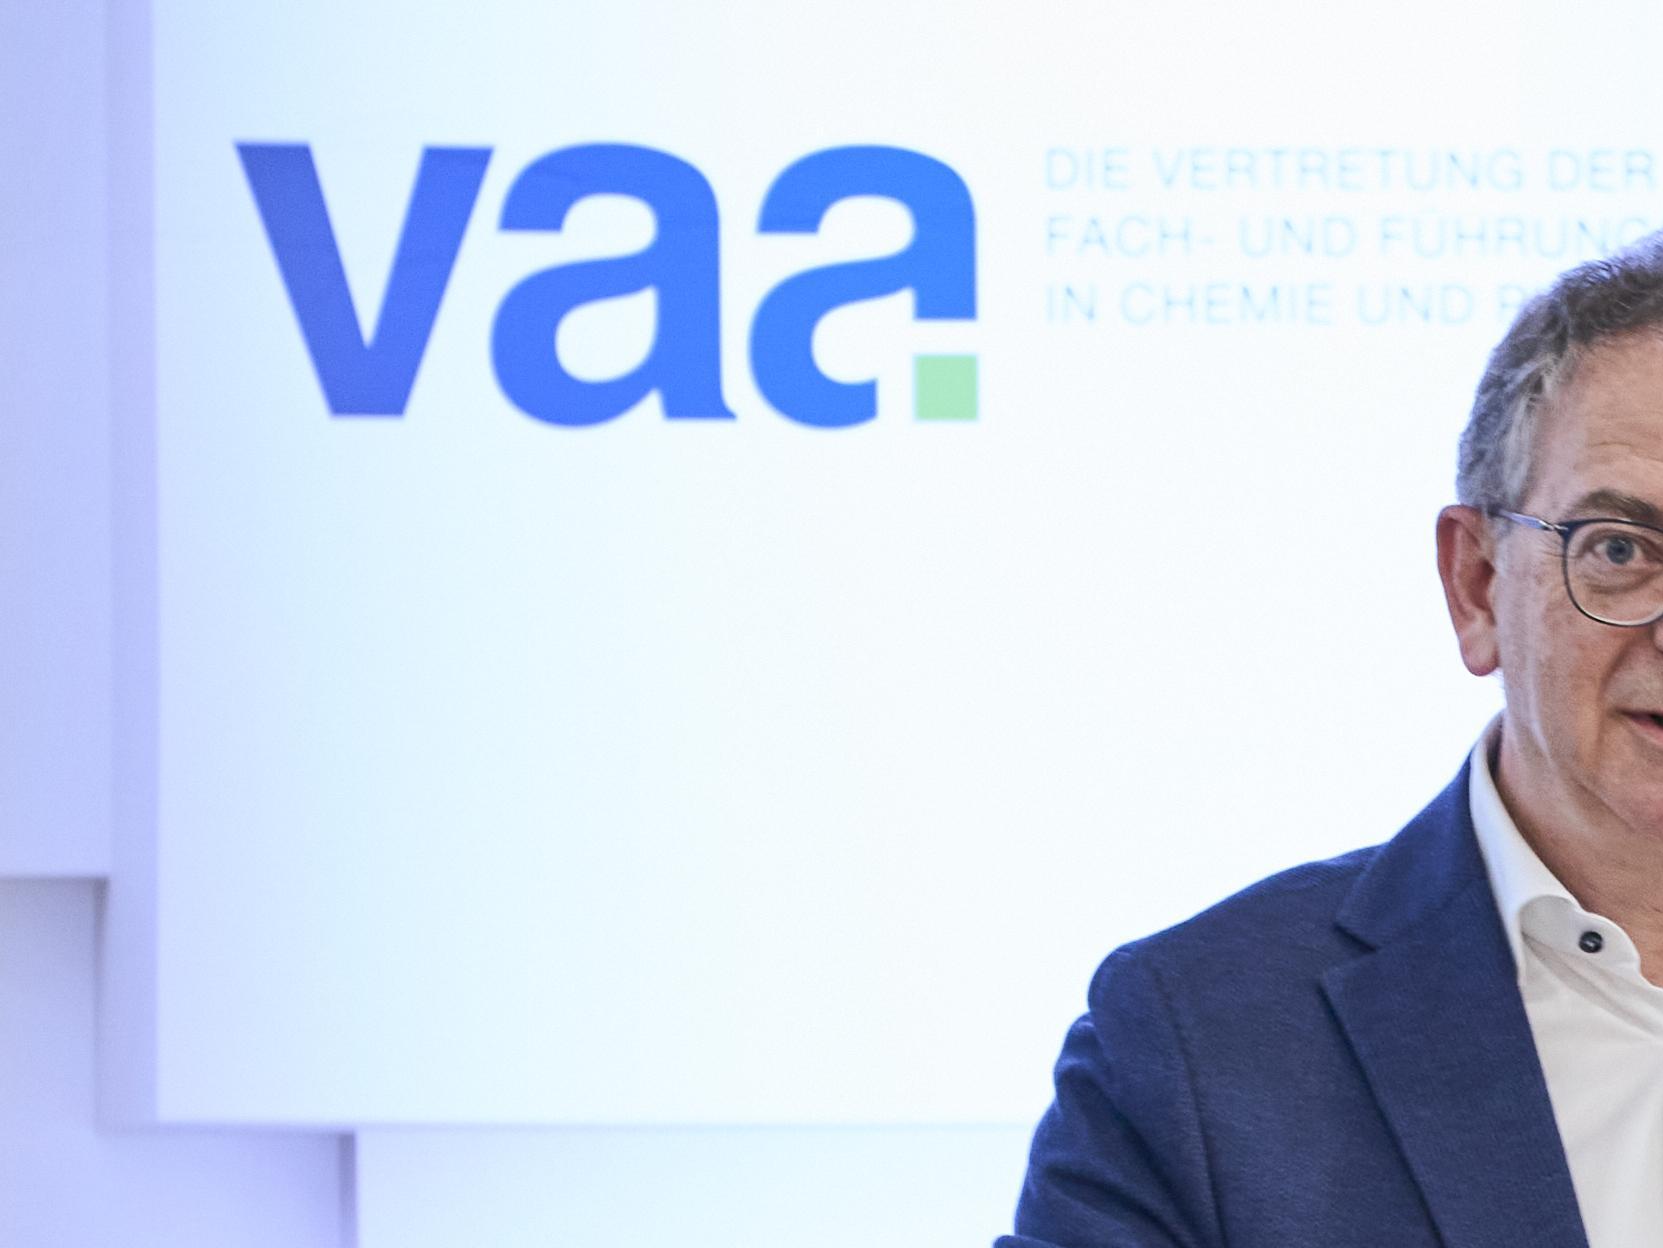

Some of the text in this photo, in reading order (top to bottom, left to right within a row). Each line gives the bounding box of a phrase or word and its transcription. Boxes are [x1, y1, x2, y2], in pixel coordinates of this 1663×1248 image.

[1044, 147, 1656, 191] DIE VERTRETUNG DER
[1044, 213, 1217, 258] FACH-
[1236, 213, 1358, 258] UND
[233, 141, 979, 429] vaa
[1044, 281, 1098, 325] IN
[1120, 281, 1335, 326] CHEMIE
[1356, 281, 1475, 326] UND
